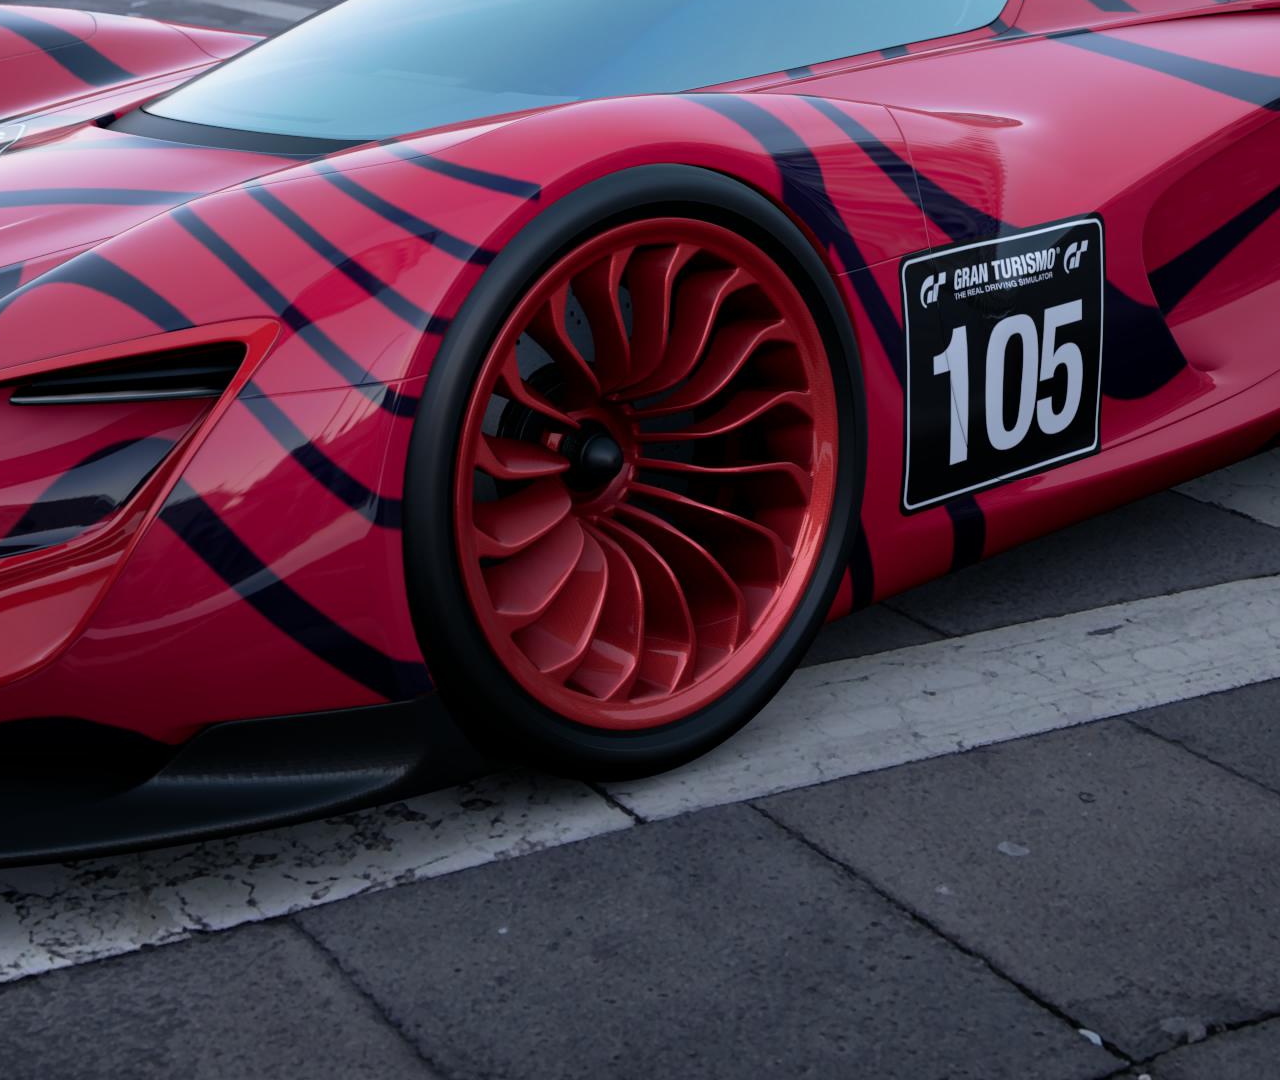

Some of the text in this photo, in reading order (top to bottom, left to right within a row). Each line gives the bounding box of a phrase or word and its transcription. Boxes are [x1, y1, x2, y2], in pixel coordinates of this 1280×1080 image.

[953, 247, 1056, 290] GRAN TURISMO
[954, 272, 1053, 301] THE REAL DRIVING SIMULATOR
[933, 299, 1083, 466] 105
